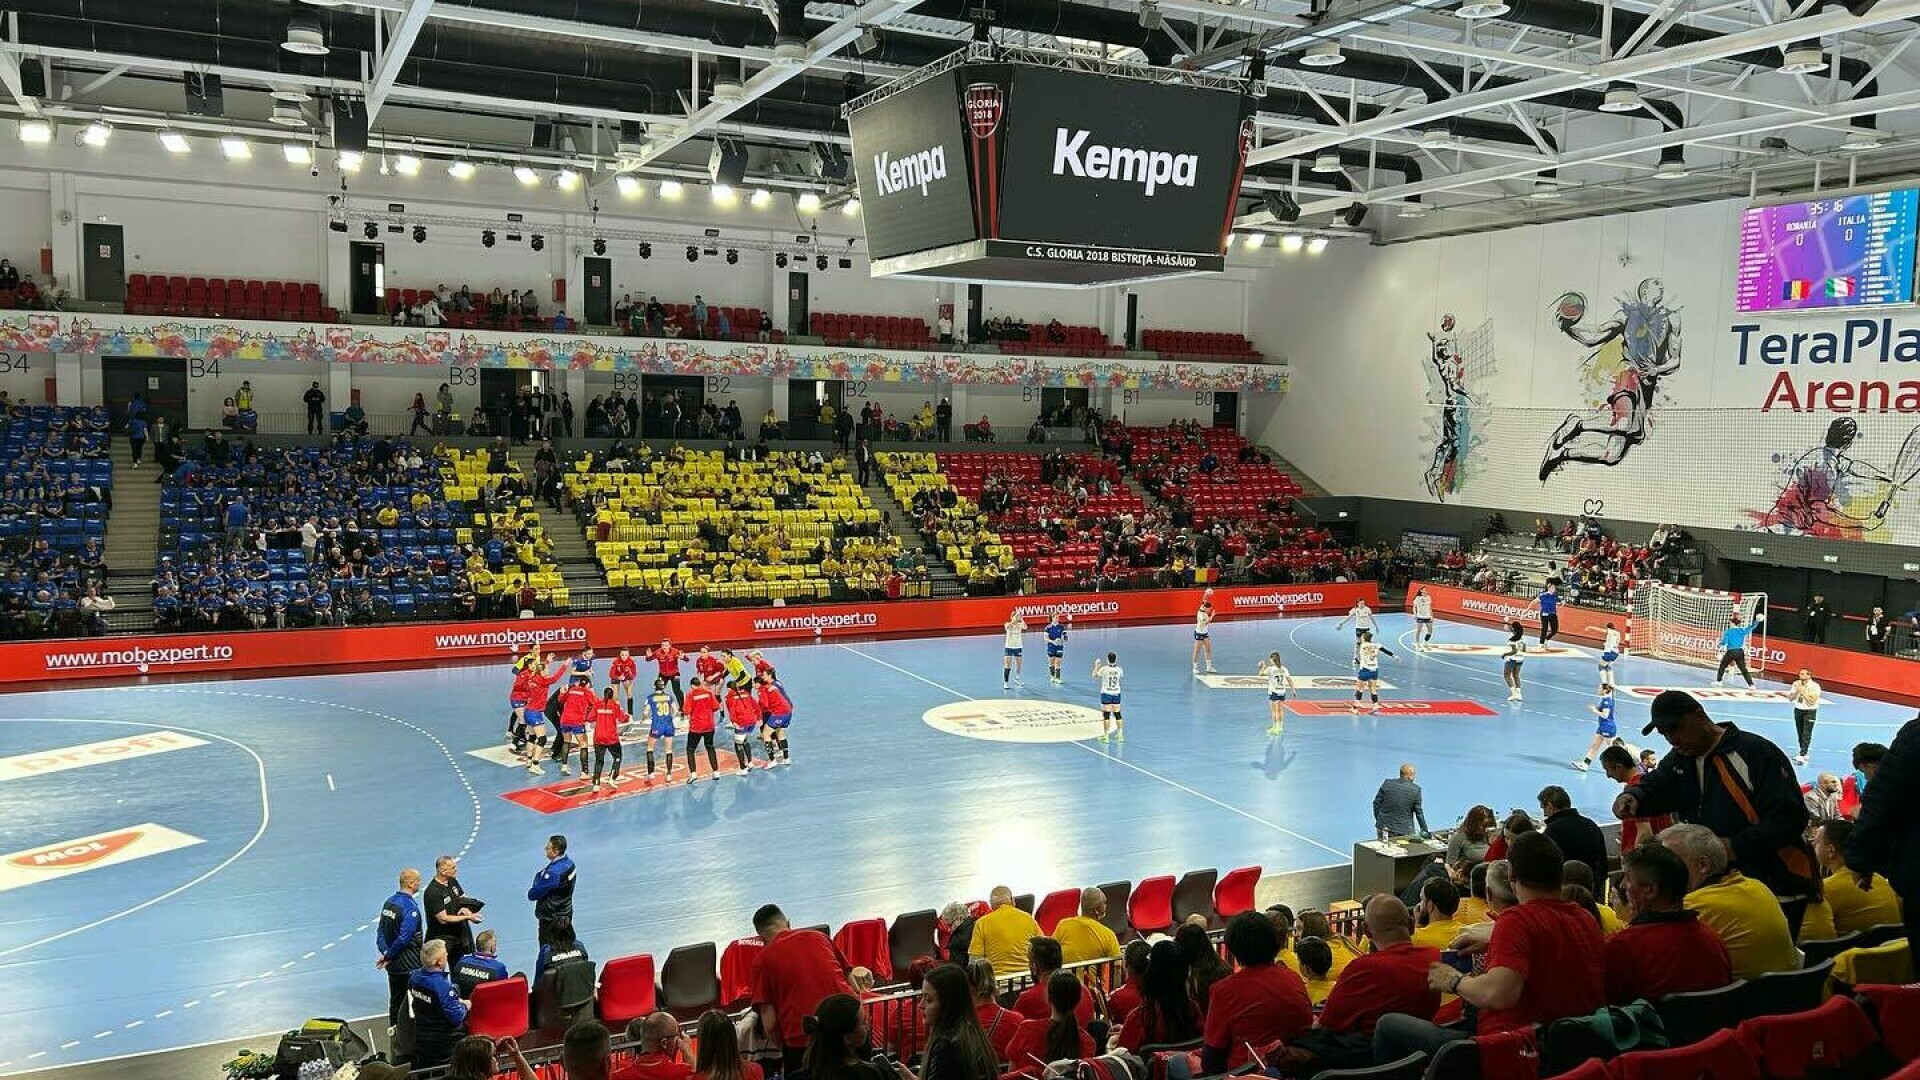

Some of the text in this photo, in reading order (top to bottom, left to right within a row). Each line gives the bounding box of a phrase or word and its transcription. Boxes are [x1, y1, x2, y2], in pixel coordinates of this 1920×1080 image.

[967, 99, 999, 109] GLORIA
[973, 110, 993, 120] 2018
[1052, 127, 1199, 196] Kempa
[874, 145, 947, 196] Kempa
[1838, 215, 1866, 226] ITALIA
[1795, 234, 1804, 246] 0
[1845, 229, 1853, 241] 0
[1026, 246, 1044, 258] C.S.
[1047, 247, 1084, 260] GLORIA
[1086, 250, 1109, 262] 2018
[1731, 318, 1920, 365] TeraPla
[190, 358, 221, 379] B4
[450, 367, 477, 386] B3
[613, 372, 639, 391] B3
[707, 376, 731, 394] B2
[846, 380, 868, 398] B2
[1023, 386, 1040, 402] B1
[1123, 389, 1140, 405] B1
[1761, 371, 1920, 413] Arena
[1584, 499, 1604, 516] C2
[1233, 592, 1324, 605] www.mobexpert.ro
[1015, 600, 1119, 615] www.mobexpert.ro
[1462, 598, 1541, 620] www.mobexper
[754, 612, 876, 629] www.mobexpert.ro
[436, 627, 586, 646] www.mobexpert.ro
[45, 645, 233, 667] www.mobexpert.ro
[656, 702, 669, 716] 30
[33, 840, 109, 865] MOL
